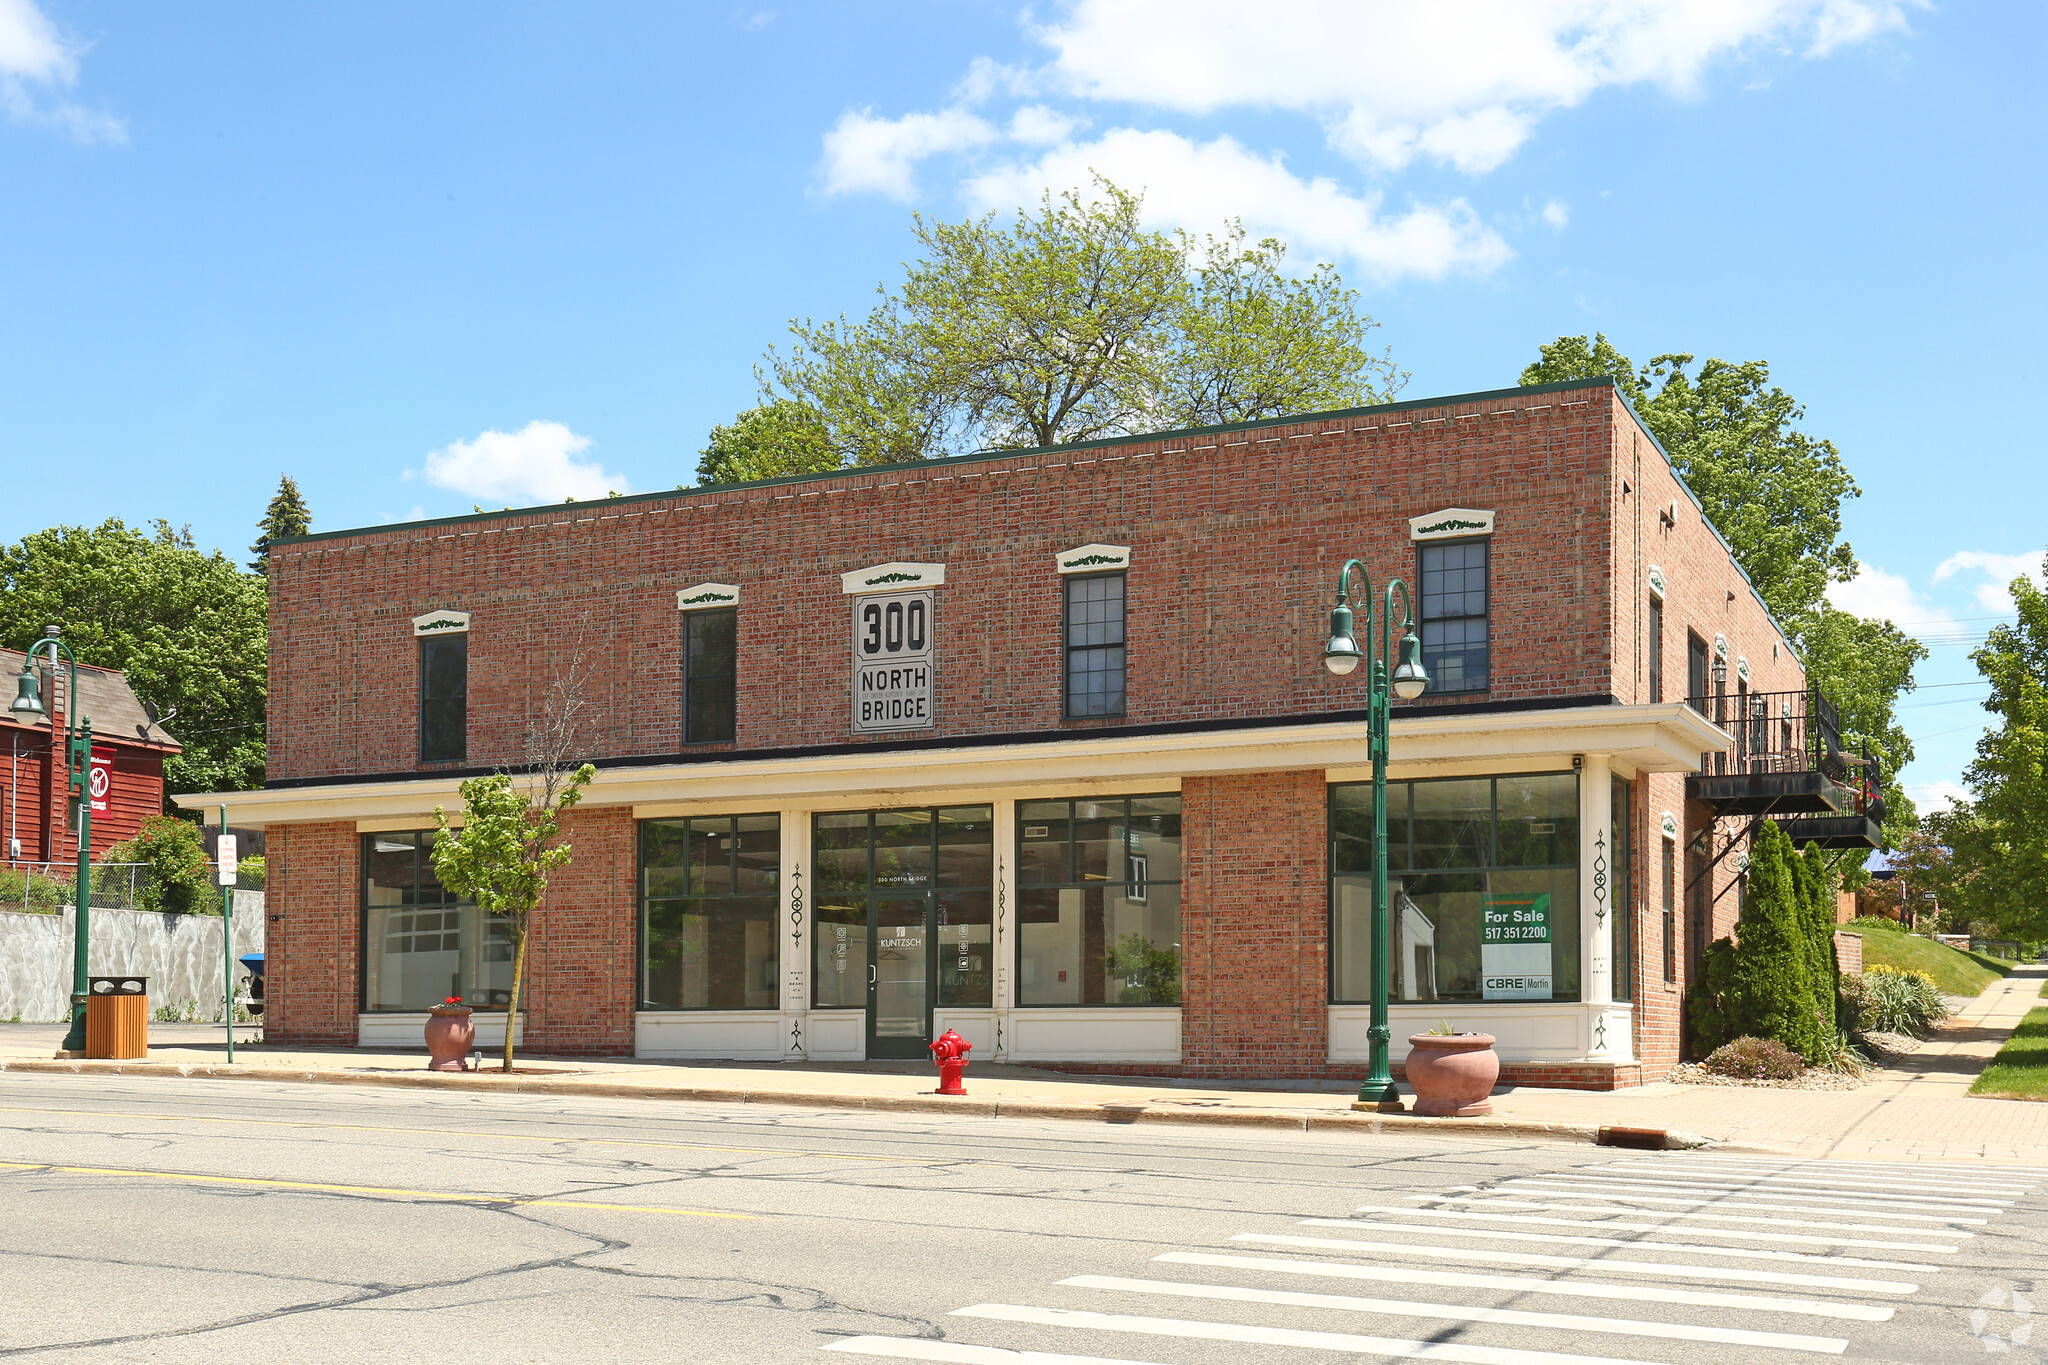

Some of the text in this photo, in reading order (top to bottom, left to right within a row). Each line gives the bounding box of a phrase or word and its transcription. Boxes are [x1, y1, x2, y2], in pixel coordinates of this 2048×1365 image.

[863, 600, 925, 654] 300
[863, 667, 925, 691] NORTH
[863, 698, 925, 721] BRIDGE
[1485, 910, 1544, 923] For Sale
[1485, 926, 1546, 939] 517 351 2200
[880, 938, 922, 947] KUNTZSCH
[1486, 978, 1549, 989] CBRE Martin
